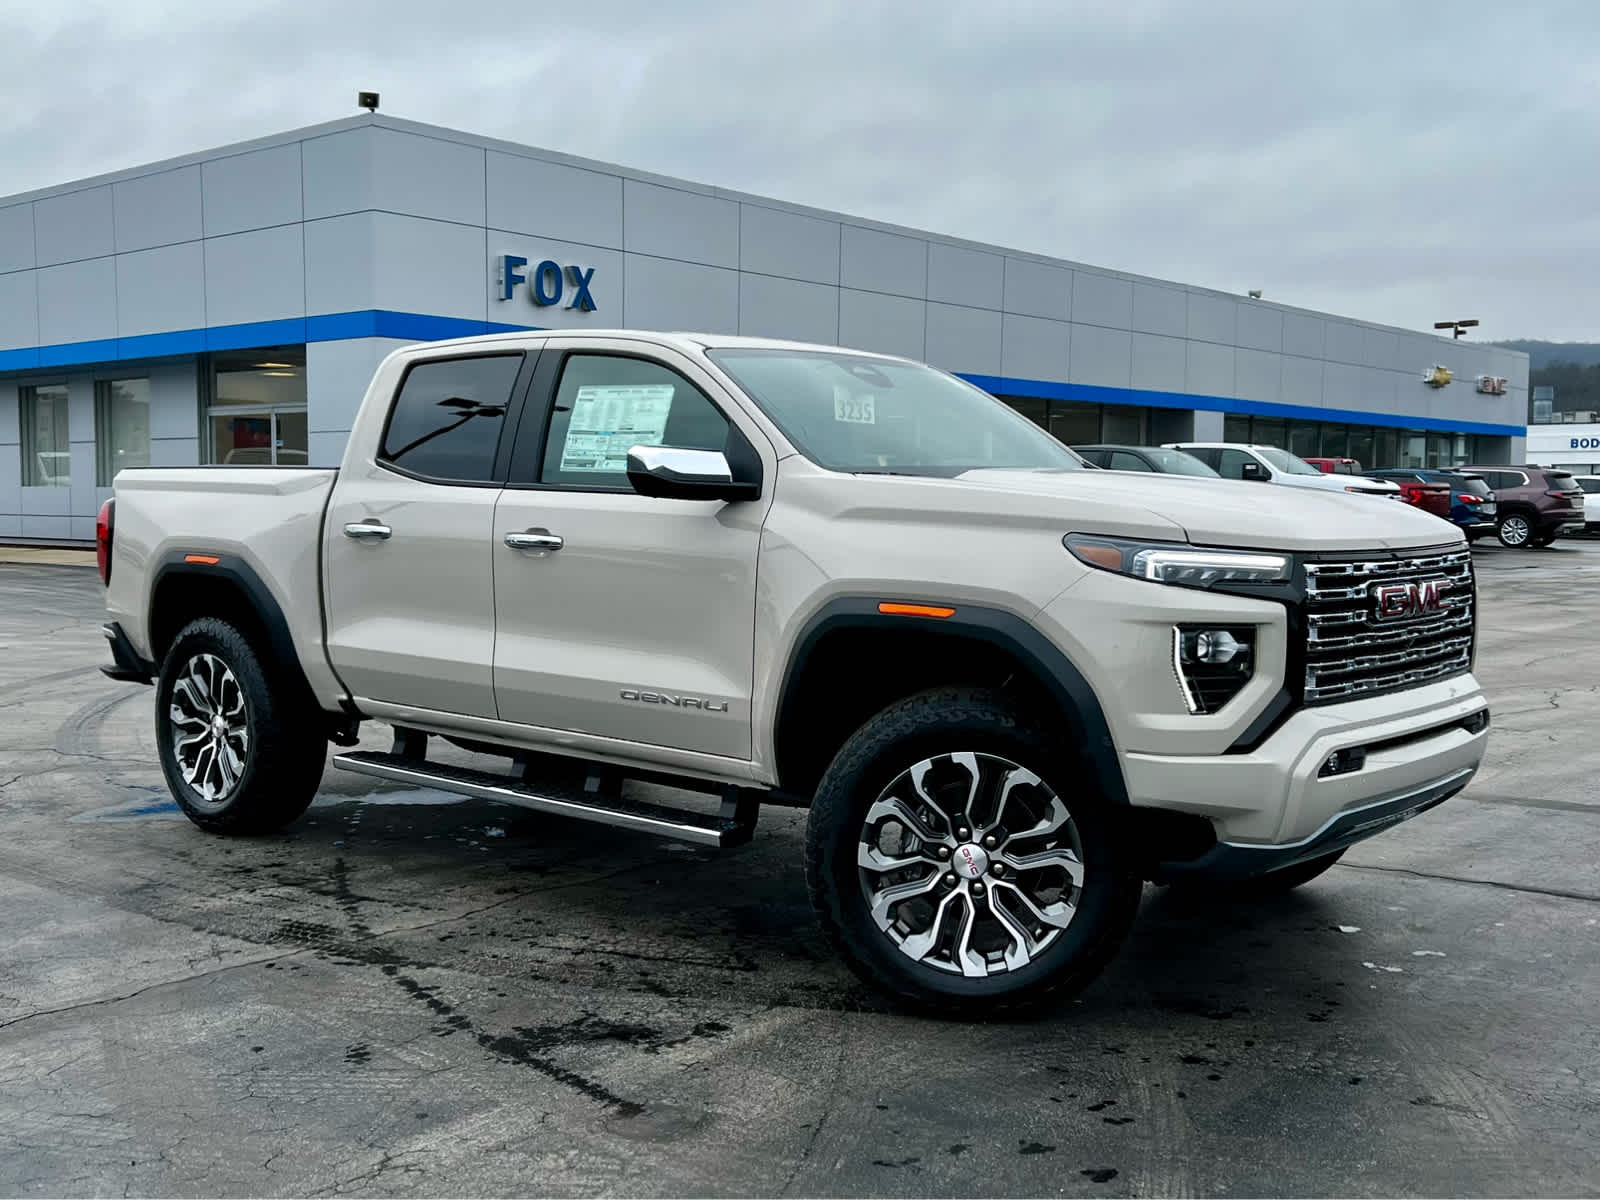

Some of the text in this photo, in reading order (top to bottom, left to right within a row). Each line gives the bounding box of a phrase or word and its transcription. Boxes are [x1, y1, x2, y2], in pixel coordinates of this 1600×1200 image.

[499, 254, 597, 312] FOX
[1377, 580, 1453, 619] GMC
[620, 688, 728, 712] DENALI
[962, 848, 979, 875] GMC
